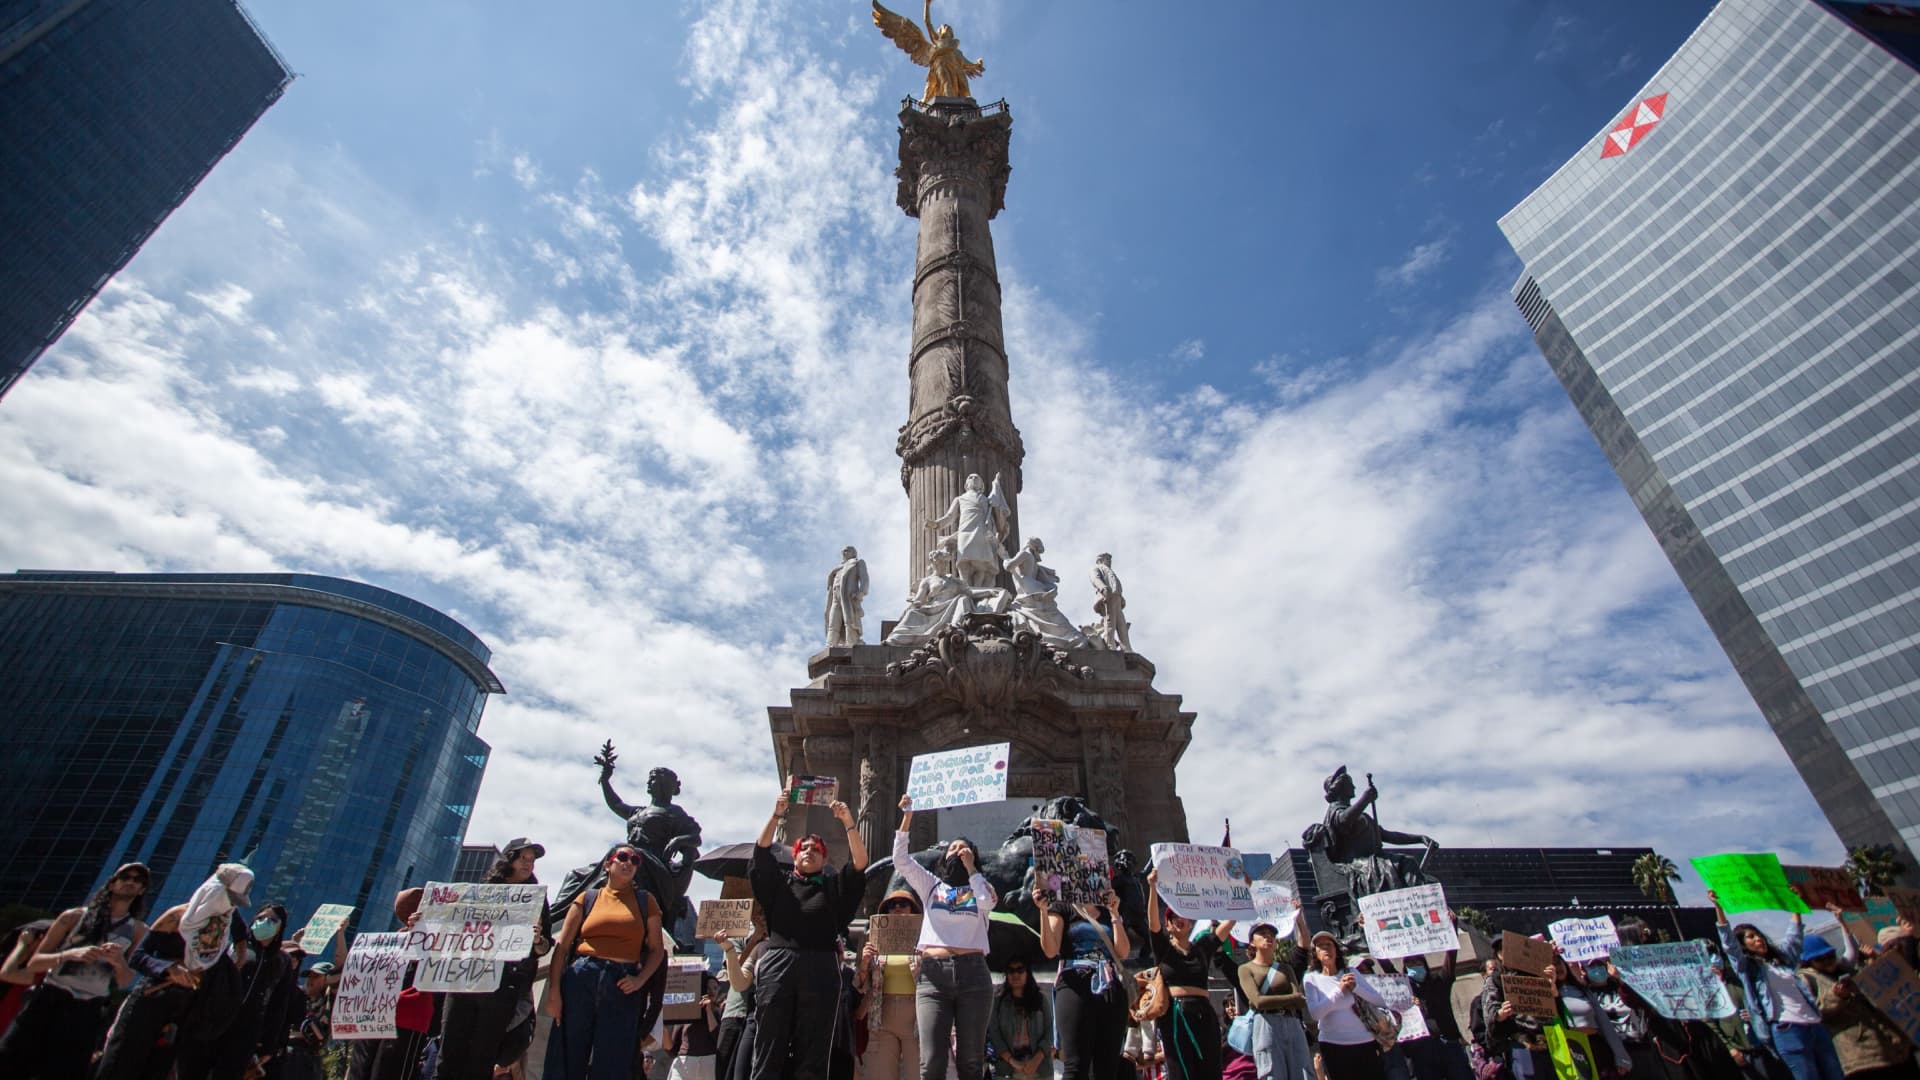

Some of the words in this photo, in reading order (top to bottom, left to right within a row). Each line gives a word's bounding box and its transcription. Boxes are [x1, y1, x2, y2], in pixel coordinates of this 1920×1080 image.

[912, 761, 931, 773] EL
[934, 754, 972, 770] AGUA
[974, 752, 991, 763] ES
[911, 772, 943, 785] VIDA
[947, 769, 955, 778] Y
[959, 764, 984, 776] POR
[911, 783, 944, 799] ELLA
[914, 797, 934, 809] LA
[939, 790, 977, 805] VIDA
[1032, 828, 1064, 847] DESDE
[511, 888, 532, 903] de
[1175, 881, 1198, 894] AGUA
[736, 900, 750, 911] NO
[463, 921, 492, 933] NO
[871, 916, 889, 929] NO
[406, 932, 495, 951] POLITICOS
[500, 929, 524, 951] de
[346, 953, 360, 971] UN
[361, 975, 378, 994] UN
[356, 1014, 376, 1024] LLORA
